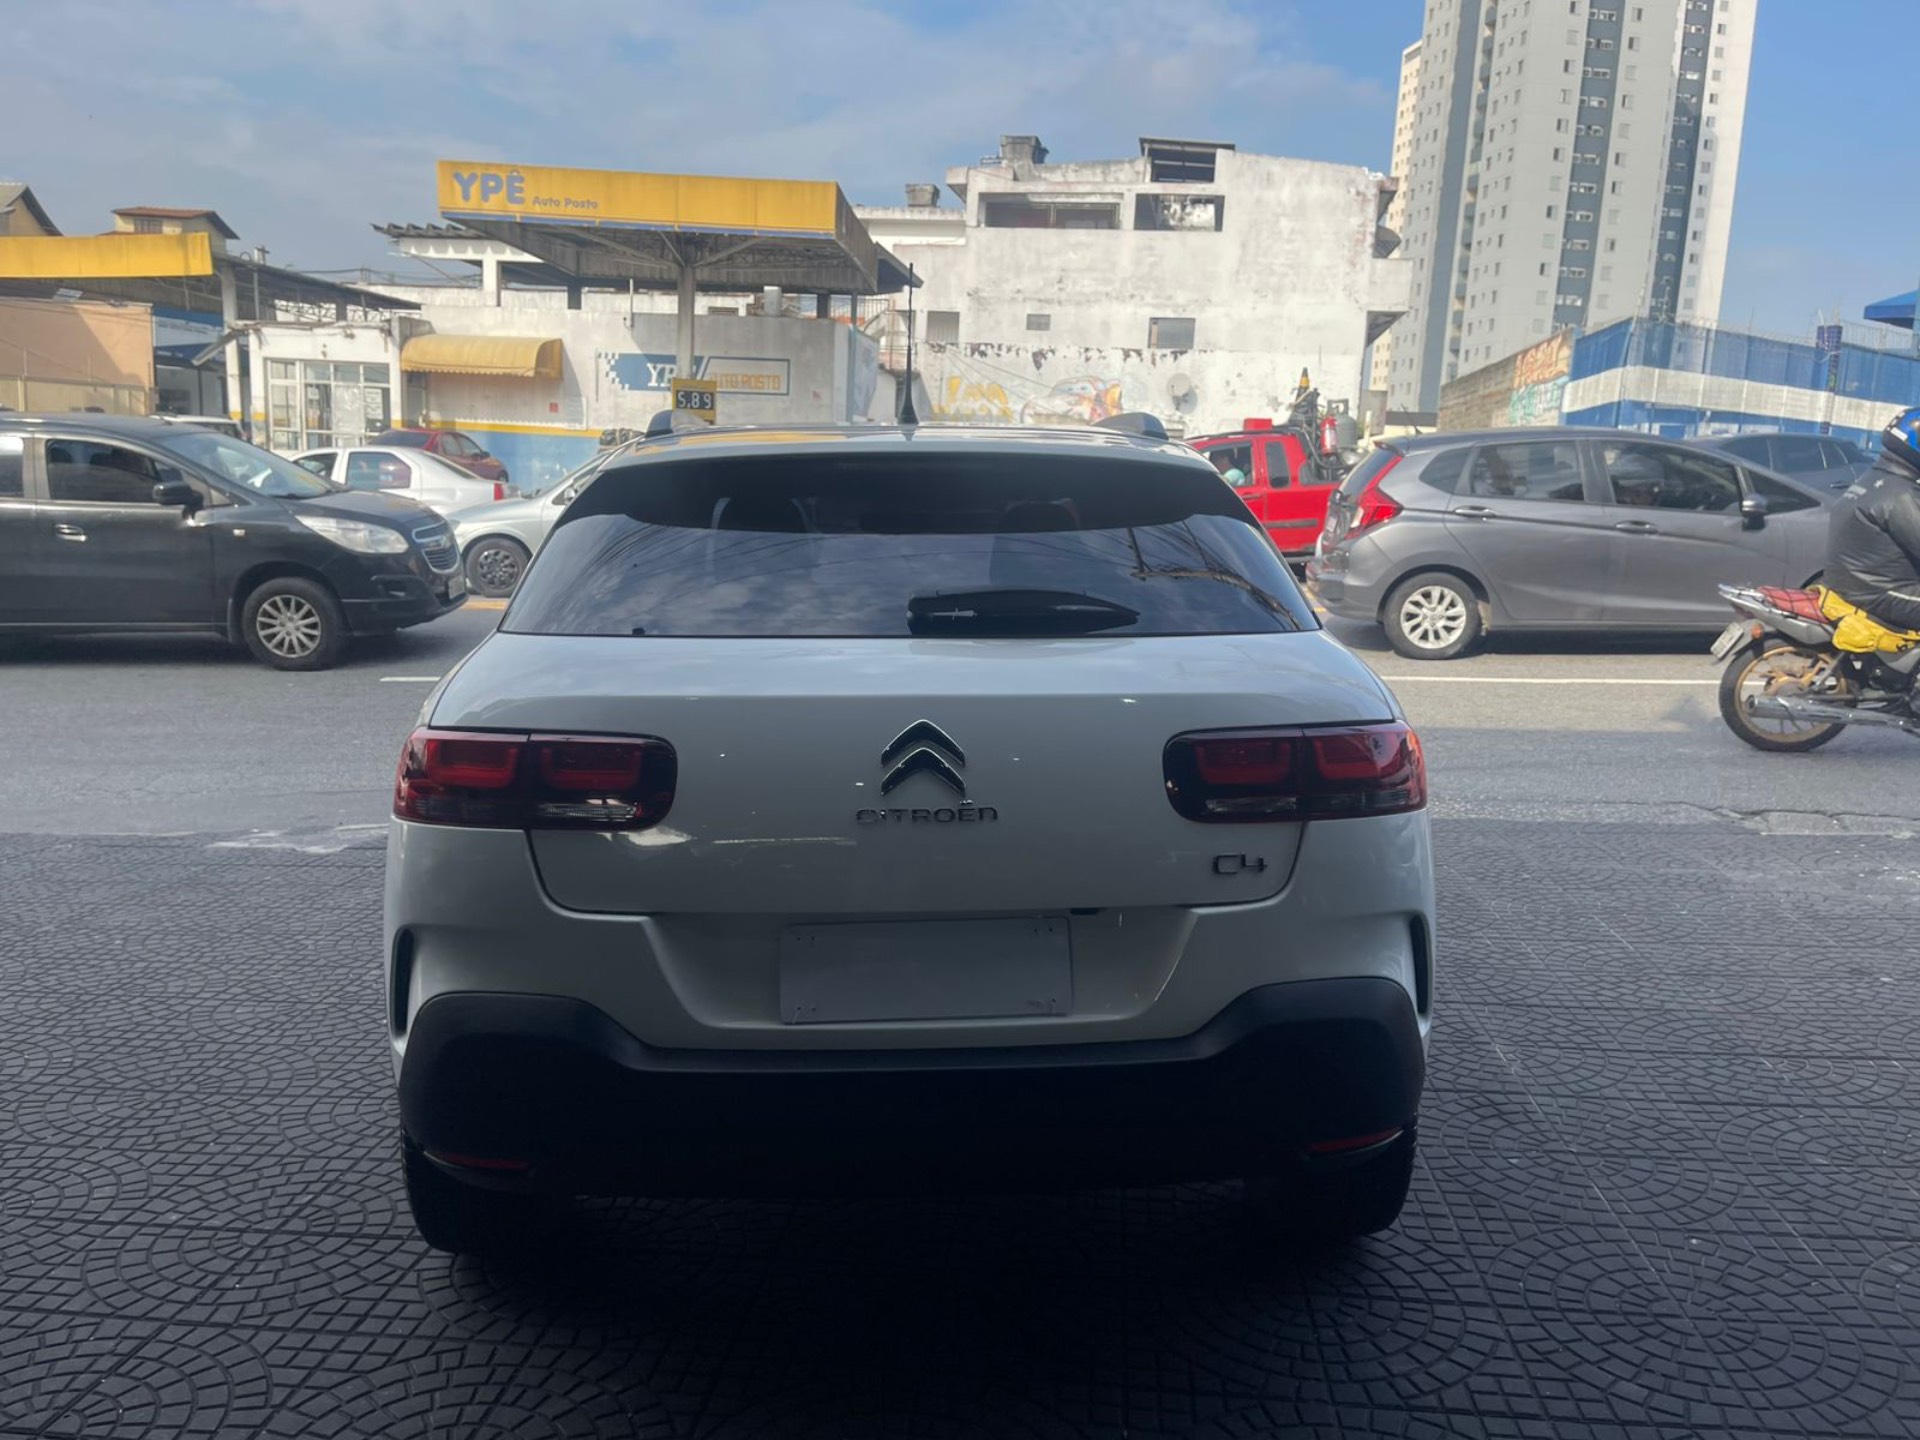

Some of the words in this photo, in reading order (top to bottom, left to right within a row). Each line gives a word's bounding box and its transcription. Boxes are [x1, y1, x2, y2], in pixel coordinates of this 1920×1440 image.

[453, 168, 526, 205] YPÊ
[532, 196, 561, 208] Auto
[564, 197, 598, 210] Posto
[1212, 854, 1267, 875] C4
